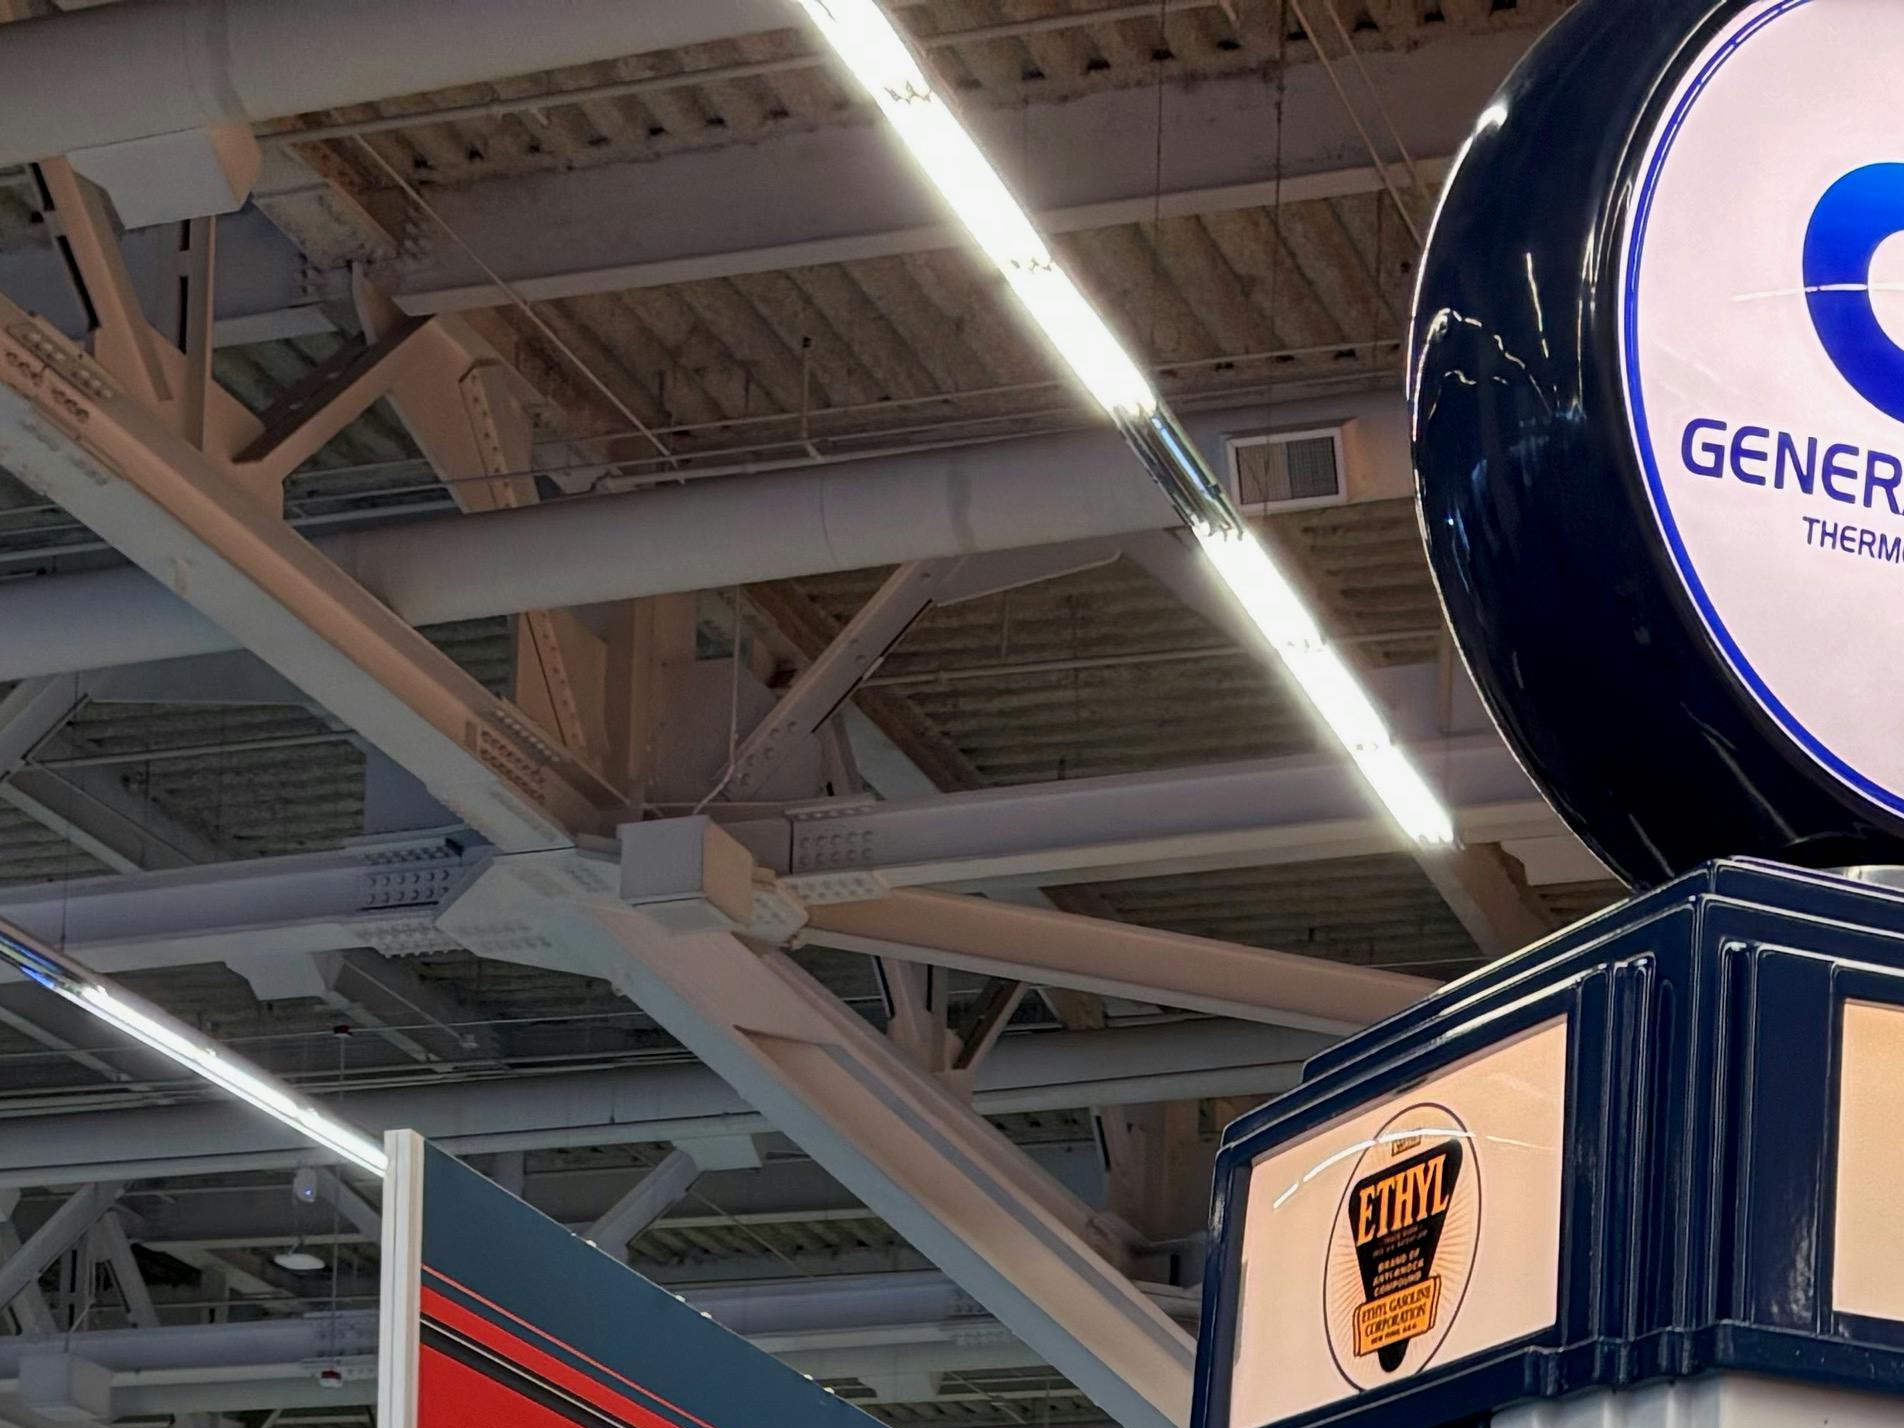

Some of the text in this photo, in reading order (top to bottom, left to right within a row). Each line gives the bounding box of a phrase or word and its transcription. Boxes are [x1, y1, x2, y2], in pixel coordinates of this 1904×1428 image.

[1356, 1153, 1450, 1247] ETHYL
[1388, 1284, 1432, 1314] GASOLINE
[1365, 1303, 1427, 1338] CORPORATION
